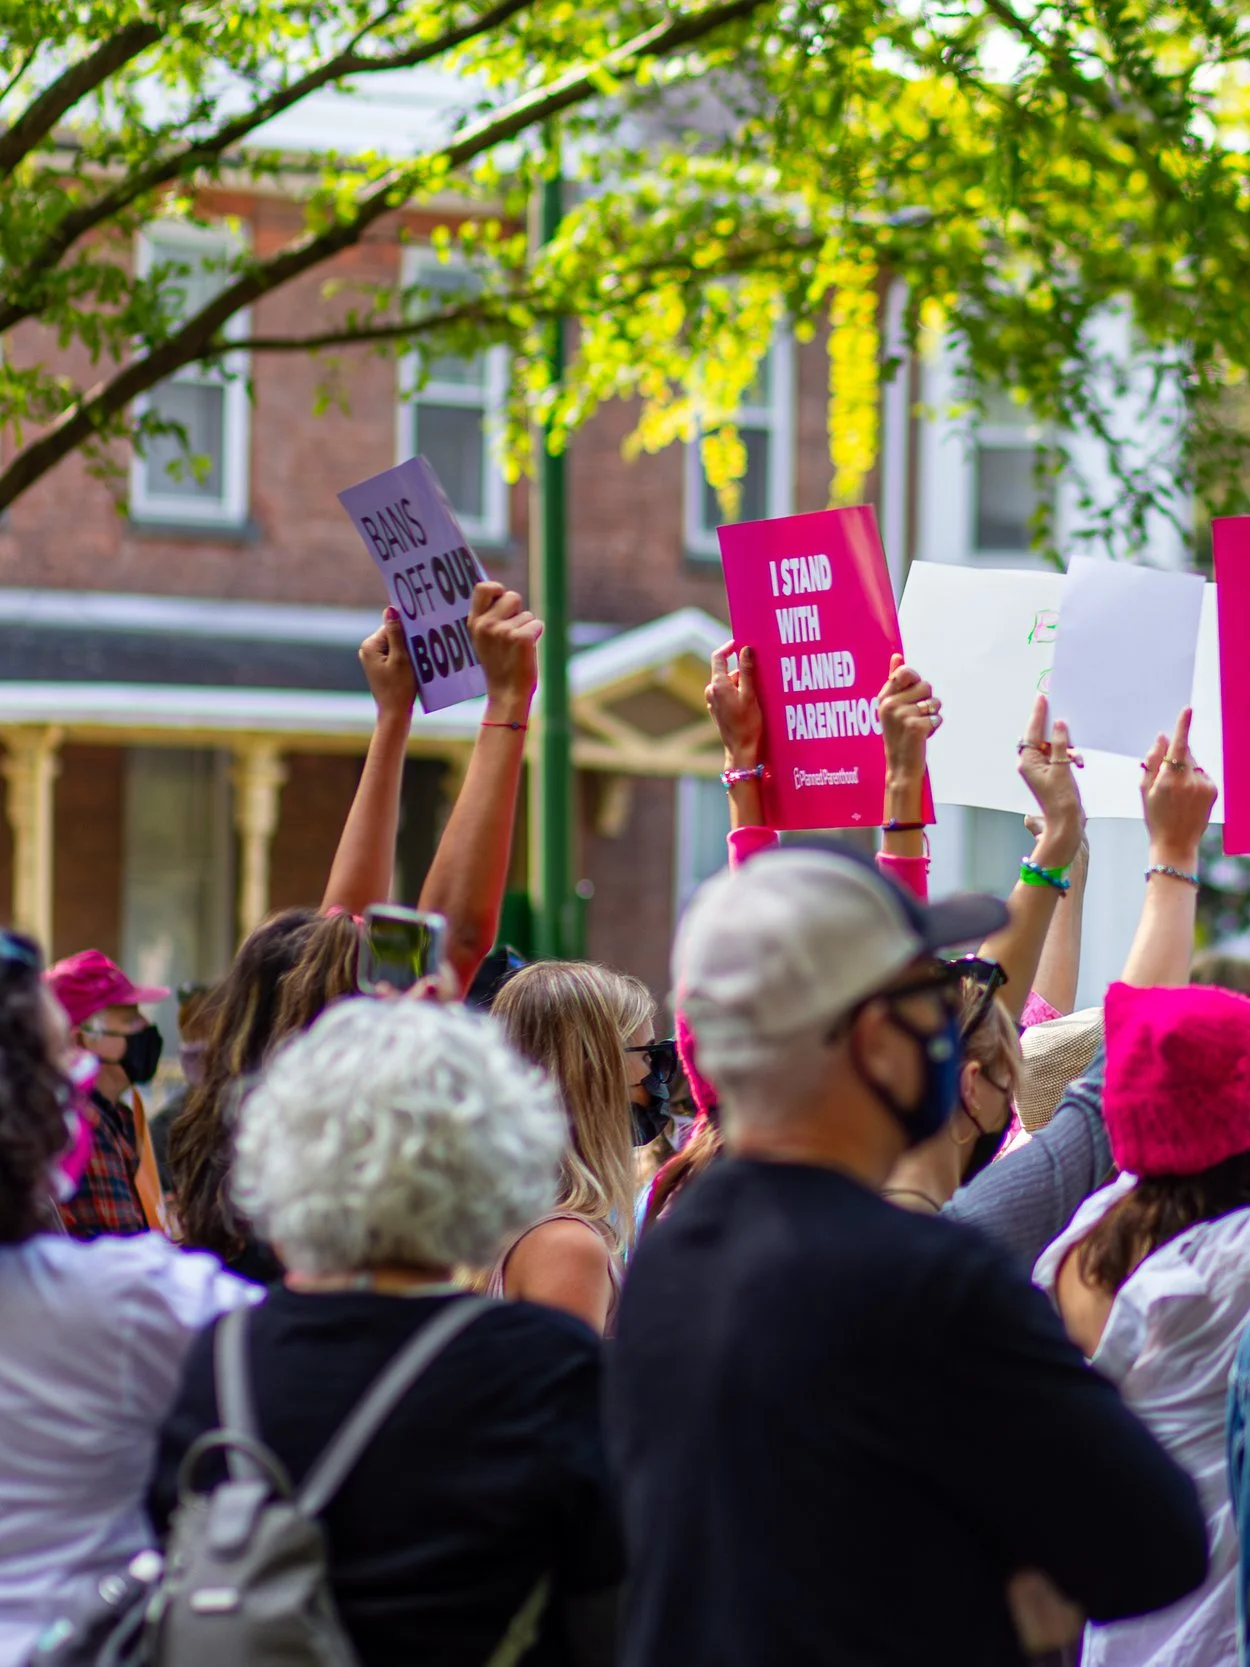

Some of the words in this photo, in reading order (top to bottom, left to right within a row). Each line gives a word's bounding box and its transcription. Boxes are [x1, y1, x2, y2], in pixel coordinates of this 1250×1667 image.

[361, 498, 427, 562] BANS
[393, 563, 435, 621] OFF
[431, 546, 482, 606] OUR
[769, 561, 779, 597] I
[781, 554, 832, 596] STAND
[775, 605, 821, 644] WITH
[410, 615, 482, 684] BODI
[780, 651, 855, 693] PLANNED
[785, 697, 884, 740] PARENTHOO
